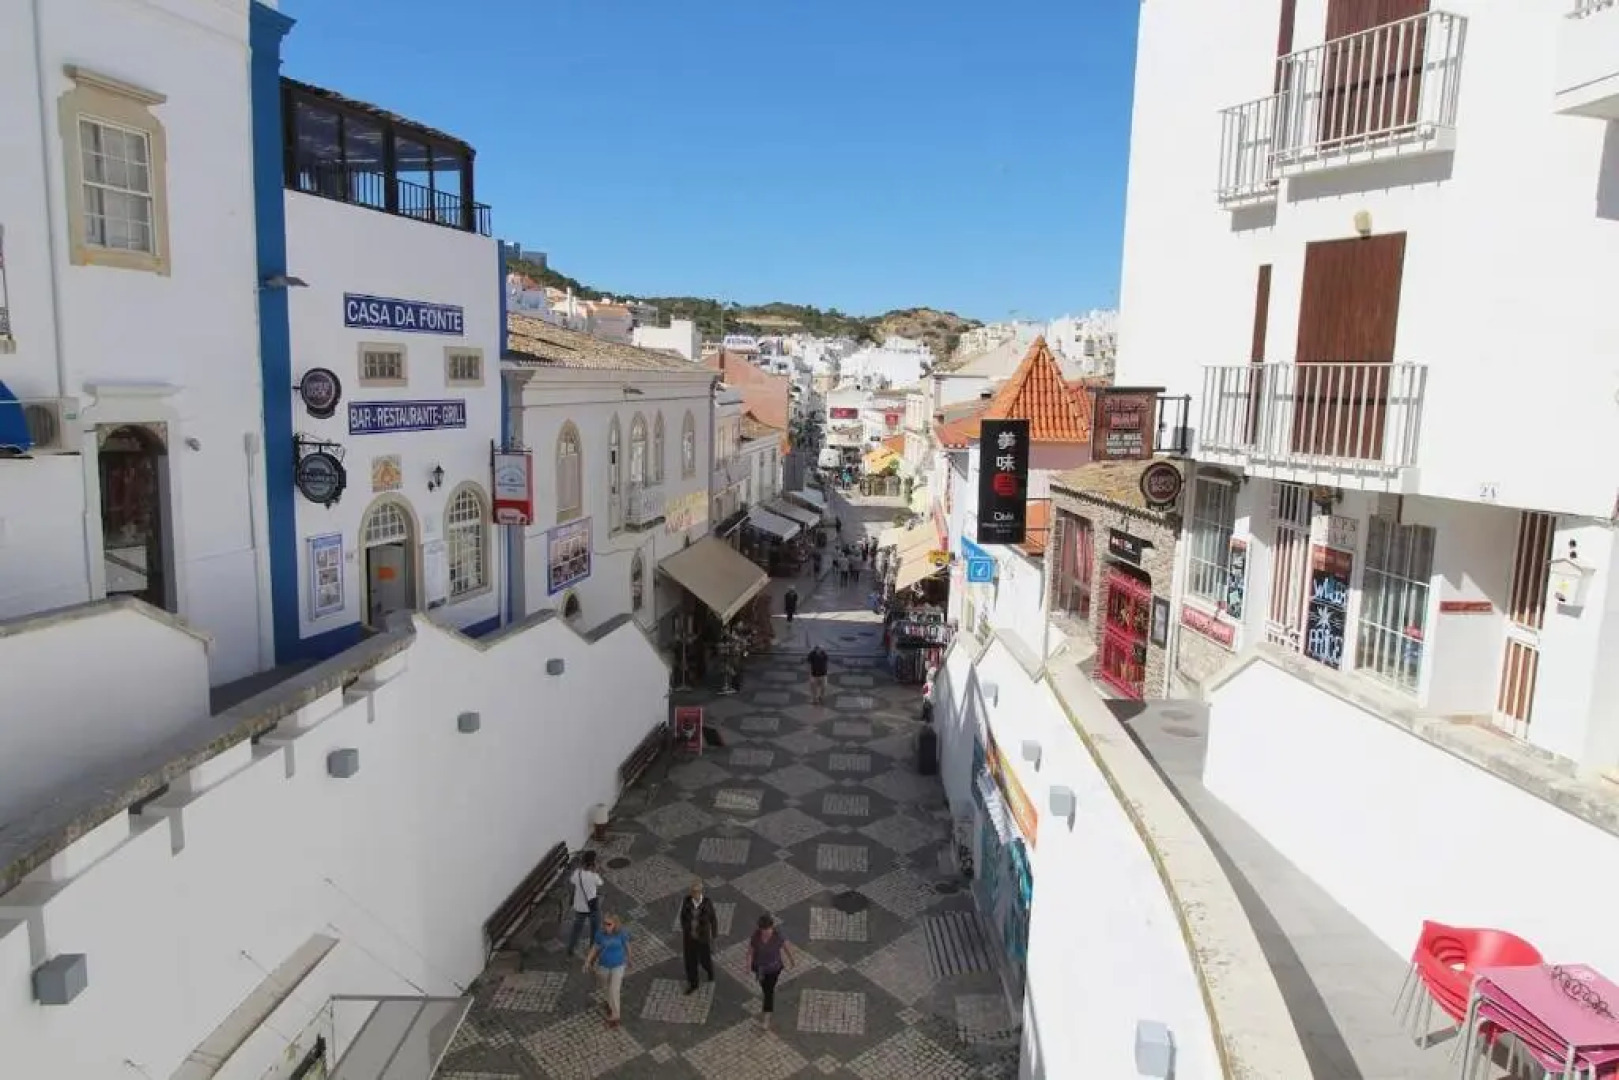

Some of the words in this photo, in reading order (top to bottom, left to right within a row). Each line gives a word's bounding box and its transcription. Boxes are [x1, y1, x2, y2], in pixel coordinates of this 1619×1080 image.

[347, 300, 390, 324] CASA
[395, 305, 415, 327] DA
[420, 308, 462, 331] FONTE
